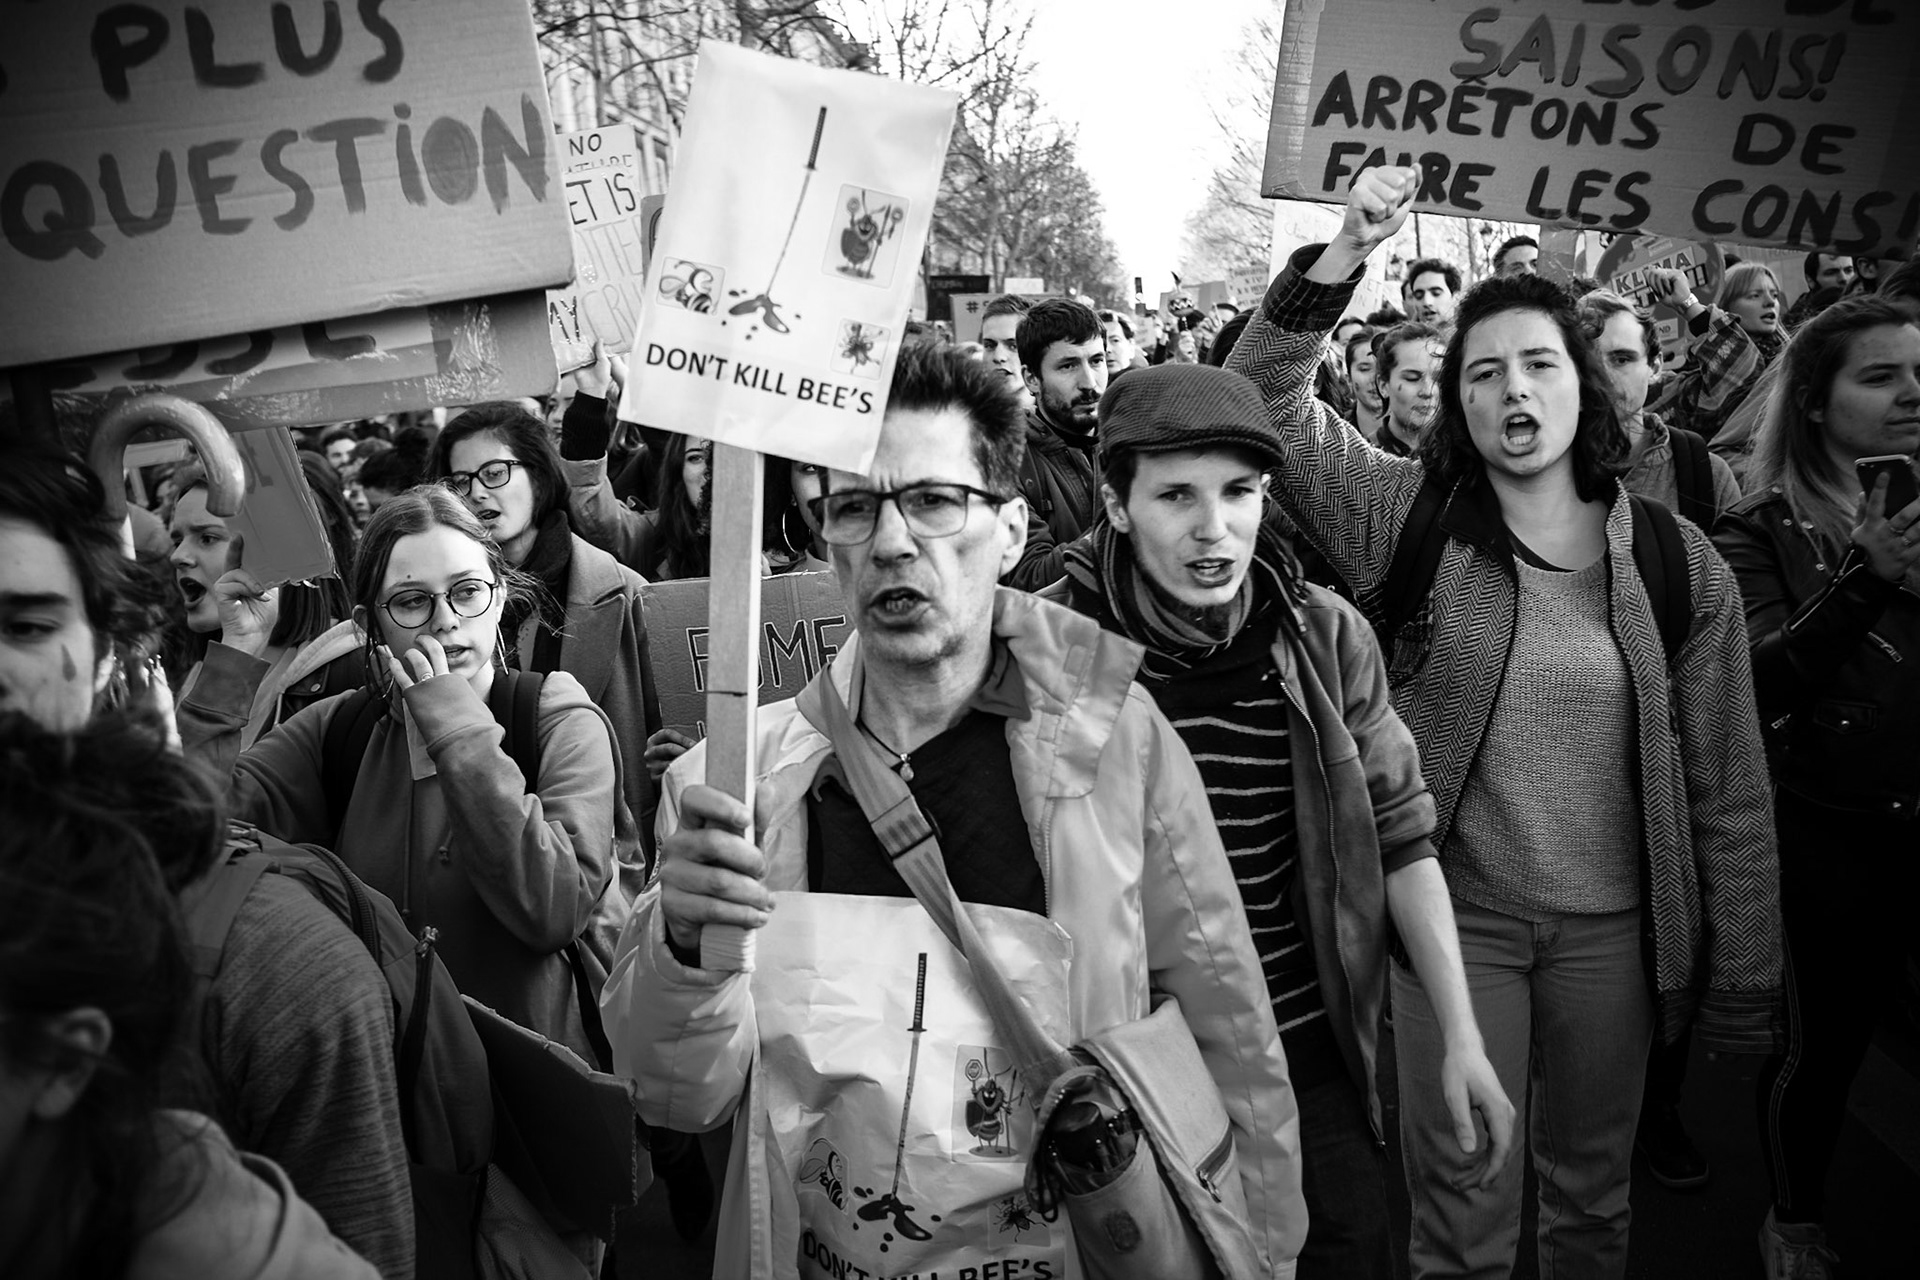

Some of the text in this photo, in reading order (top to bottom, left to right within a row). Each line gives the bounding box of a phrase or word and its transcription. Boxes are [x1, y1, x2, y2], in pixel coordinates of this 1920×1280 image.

[92, 0, 404, 101] PLUS
[1450, 8, 1848, 102] SAISONS!
[568, 133, 602, 157] NO
[1311, 70, 1857, 174] ARRÊTONS DE
[605, 172, 636, 215] IS
[1525, 165, 1652, 229] LES
[646, 342, 874, 415] DON'T KILL BEE'S
